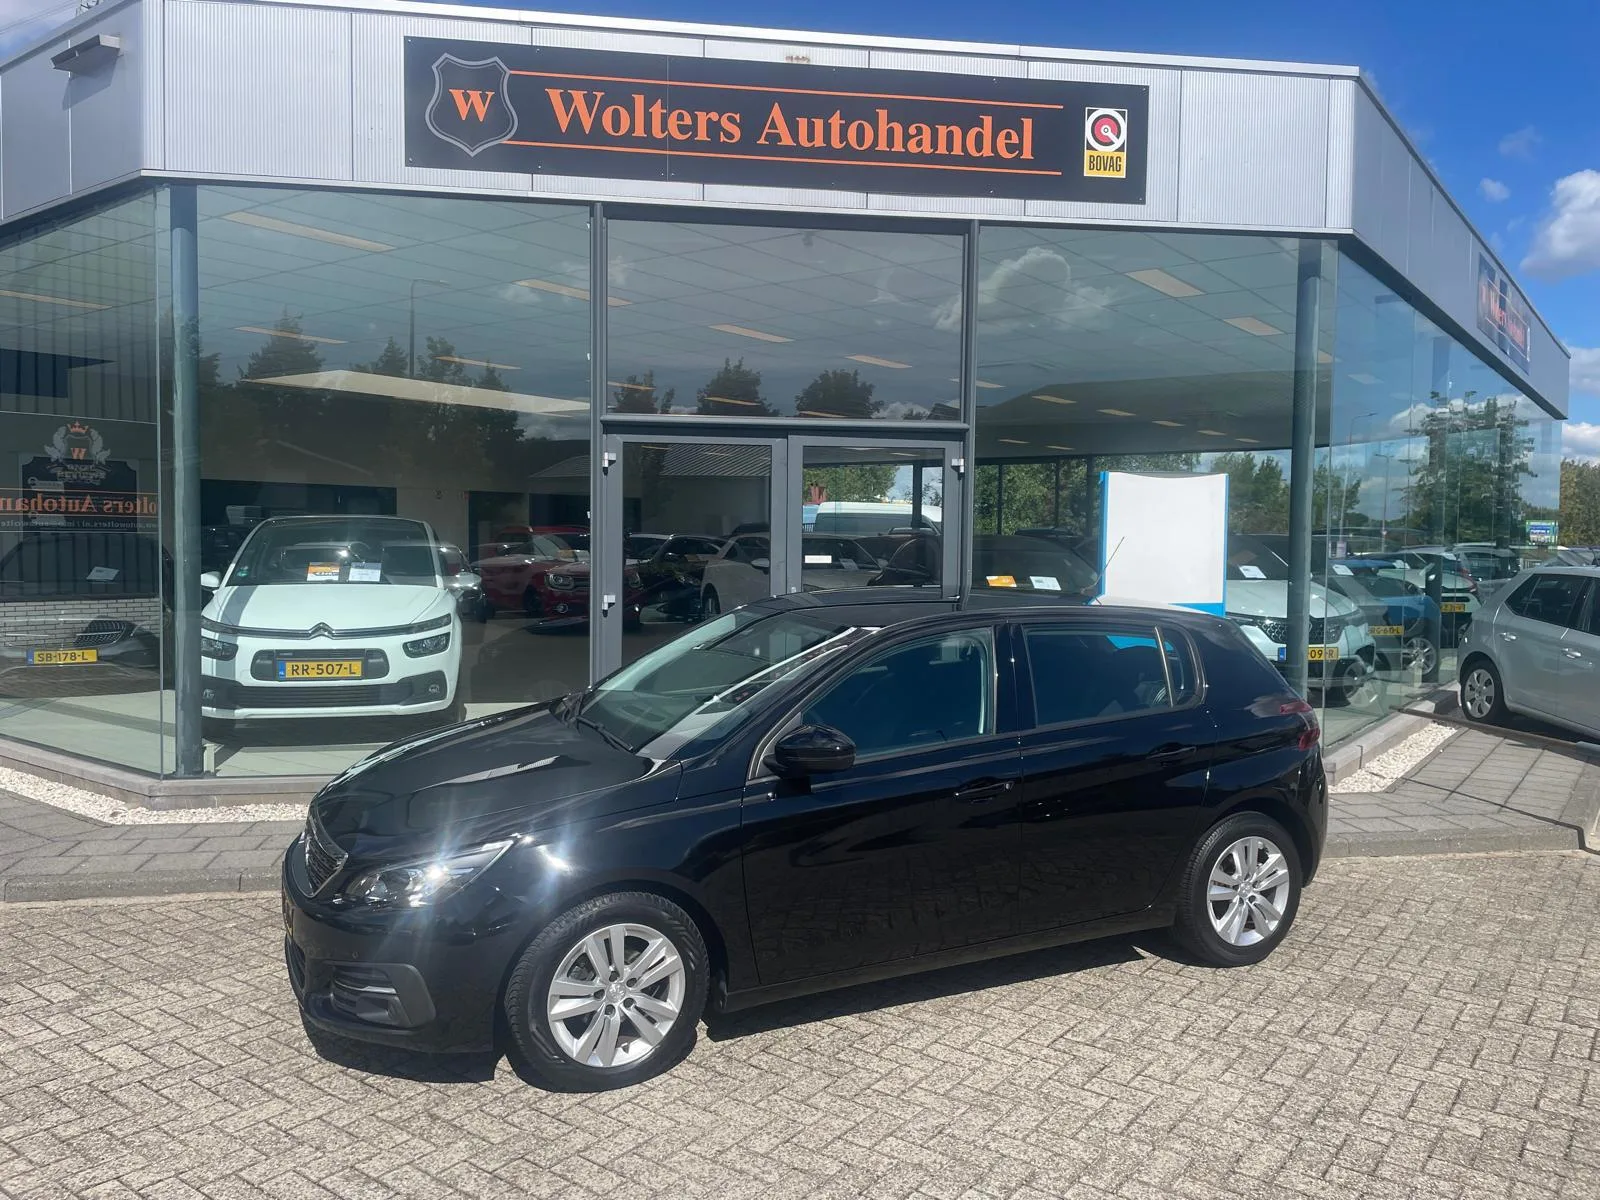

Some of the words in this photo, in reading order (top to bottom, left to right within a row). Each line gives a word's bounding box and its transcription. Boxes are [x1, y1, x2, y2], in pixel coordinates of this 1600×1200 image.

[449, 88, 495, 122] W
[544, 88, 742, 143] Wolters
[757, 102, 1035, 160] Autohandel
[1088, 155, 1122, 172] BOVAG
[37, 652, 88, 662] SB-178-L
[1308, 649, 1334, 659] 09-R
[291, 663, 357, 675] RR-507-L
